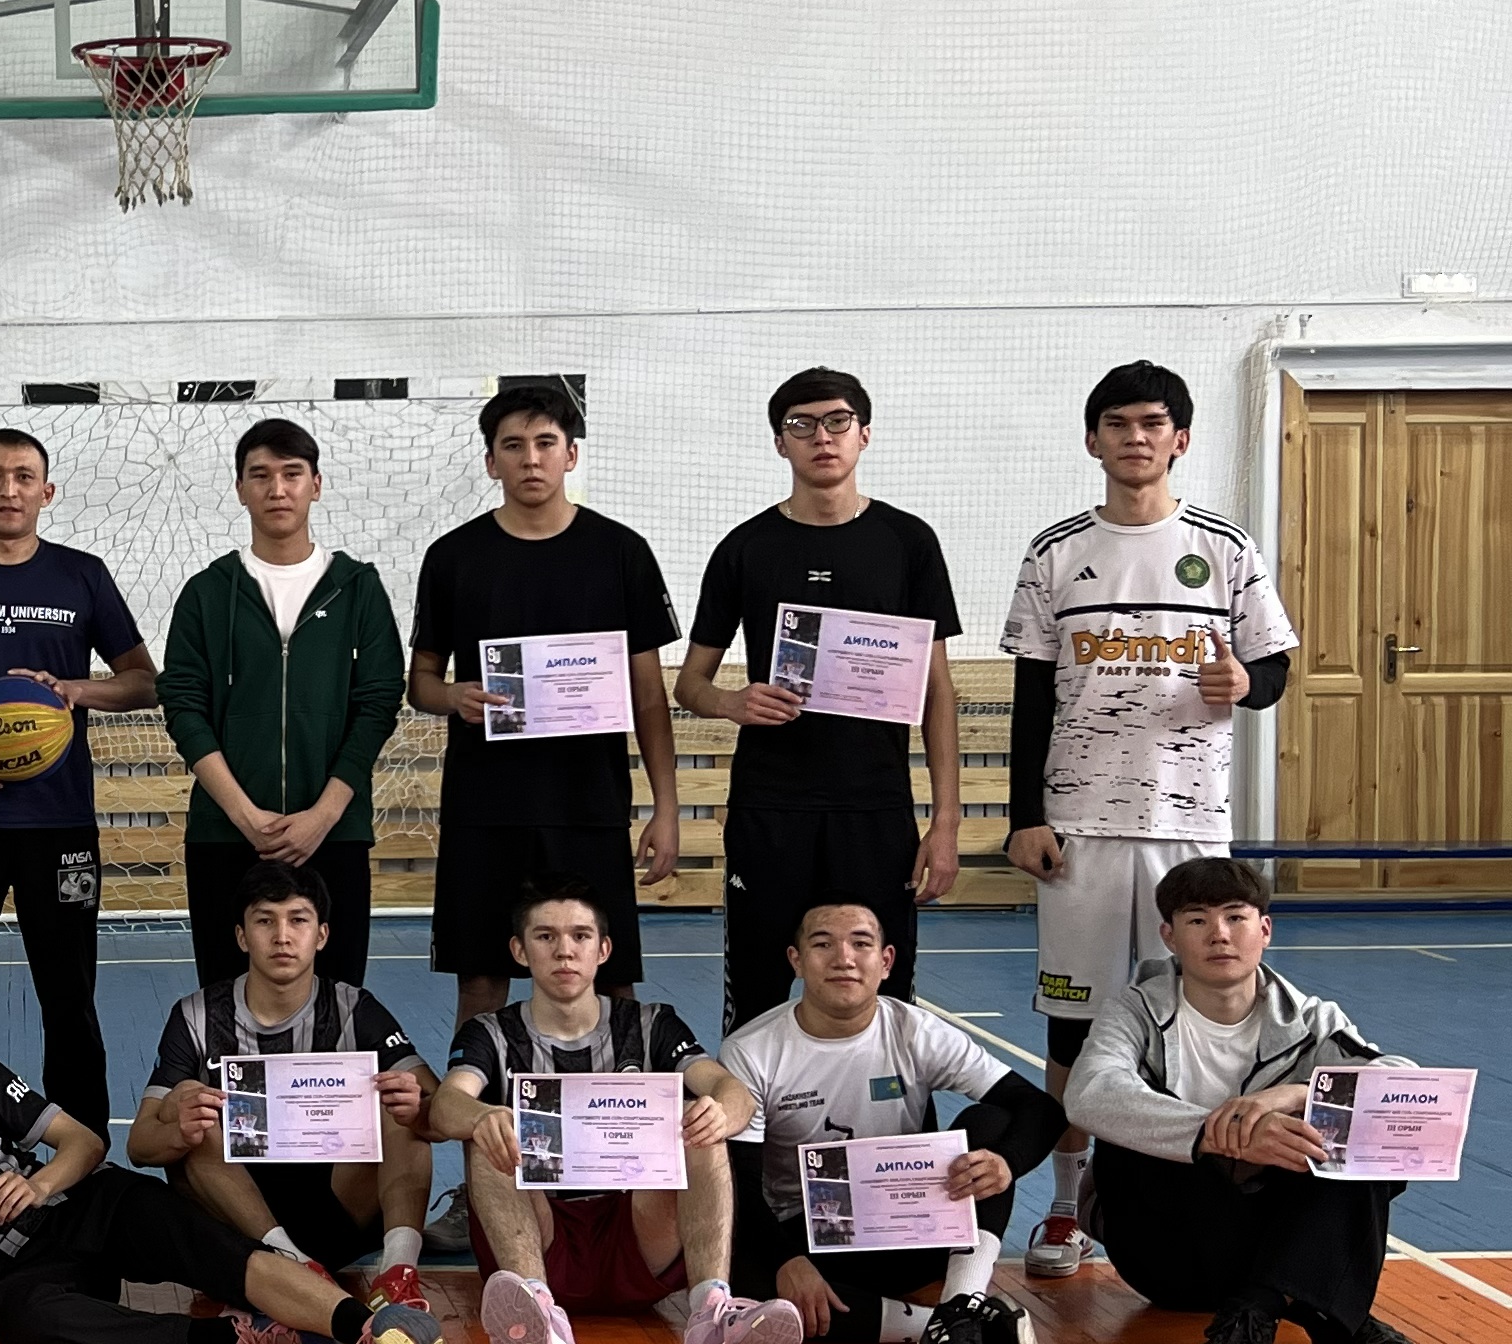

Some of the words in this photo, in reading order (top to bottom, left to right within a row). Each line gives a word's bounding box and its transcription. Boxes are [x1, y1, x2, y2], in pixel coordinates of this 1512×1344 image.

[10, 606, 76, 624] UNIVERSITY
[843, 635, 899, 650] ДИПЛОМ
[546, 657, 597, 668] ДИПЛОМ
[1096, 666, 1131, 676] FAST
[1135, 666, 1171, 676] FOOD
[61, 851, 93, 865] NASA
[1044, 986, 1088, 1000] MATCH
[291, 1077, 346, 1088] ДИПЛОМ
[588, 1098, 647, 1109] ДИПЛОМ
[808, 1098, 825, 1107] TEAM
[1380, 1093, 1438, 1104] ДИПЛОМ
[875, 1160, 934, 1173] ДИПЛОМ
